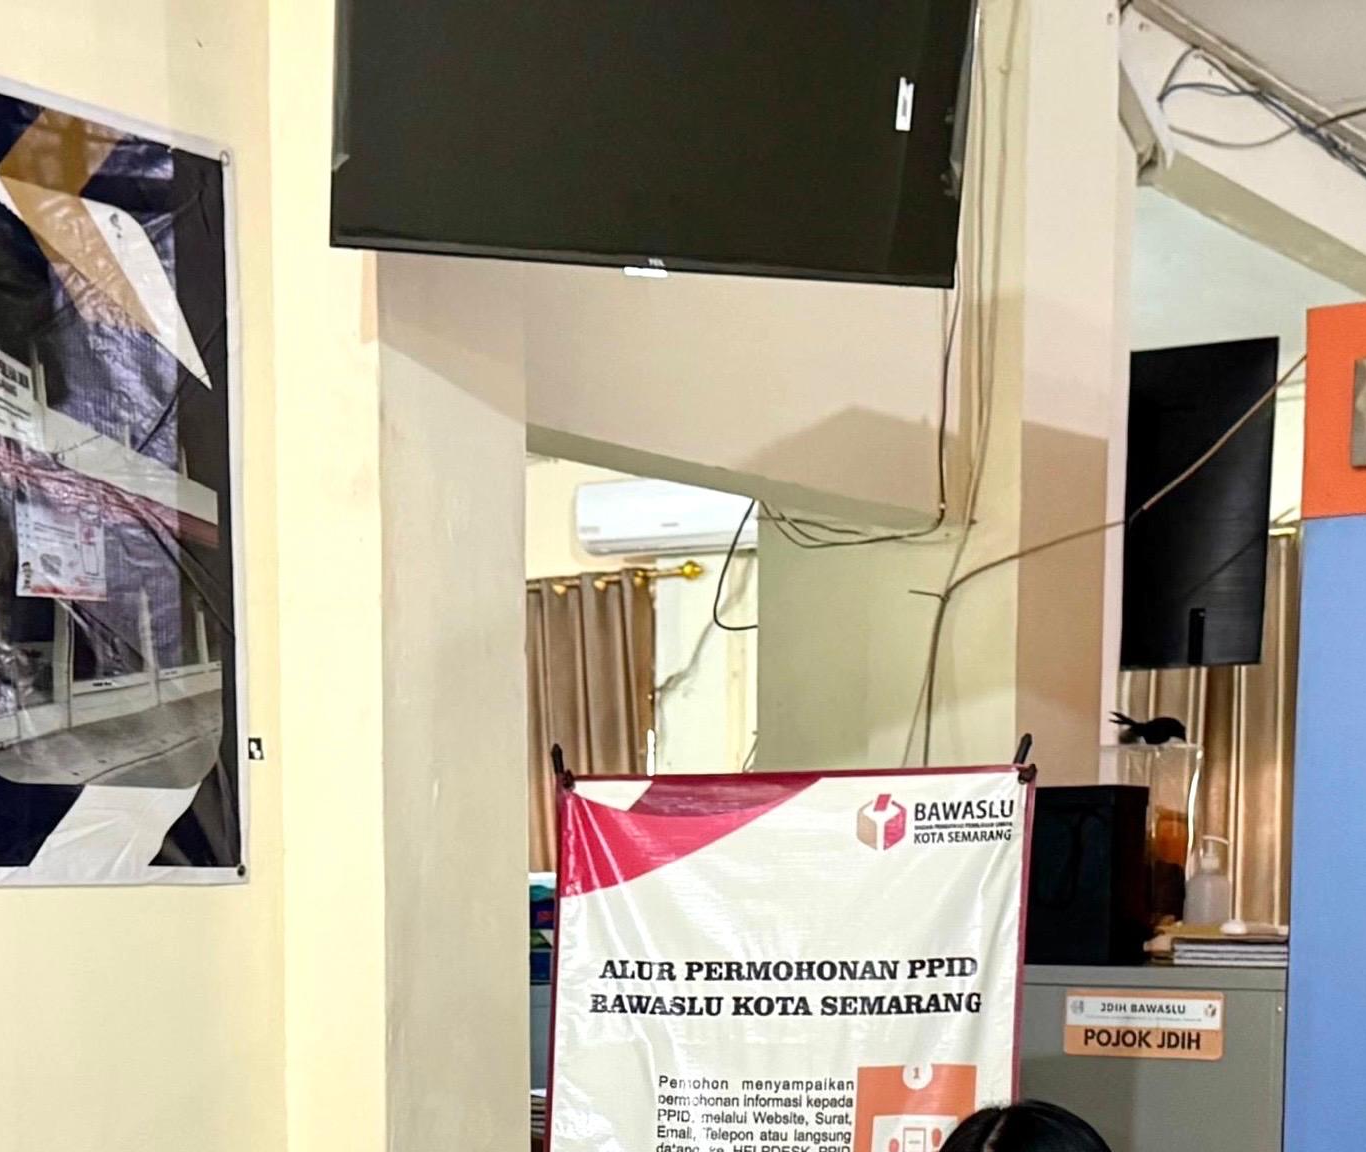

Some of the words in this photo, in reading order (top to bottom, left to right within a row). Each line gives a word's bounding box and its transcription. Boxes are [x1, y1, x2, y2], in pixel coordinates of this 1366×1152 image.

[915, 800, 1014, 821] BAWASLU
[914, 832, 944, 844] KOTA
[948, 830, 1011, 843] SEMARANG
[599, 960, 675, 981] ALUR
[685, 960, 900, 981] PERMOHONAN
[908, 957, 978, 978] PPID
[590, 994, 724, 1016] BAWASLU
[731, 996, 813, 1016] KOTA
[820, 992, 982, 1016] SEMARANG
[1101, 1003, 1127, 1012] JDIH
[1131, 1004, 1185, 1014] BAWASLU
[1084, 1029, 1151, 1048] POJOK
[1157, 1031, 1201, 1050] JDIH
[742, 1078, 854, 1093] menyampaikan
[744, 1095, 802, 1107] informasi
[807, 1096, 853, 1109] kepada
[753, 1112, 808, 1126] Website,
[815, 1113, 852, 1125] Surat,
[760, 1130, 787, 1141] atau
[794, 1129, 851, 1144] langsung
